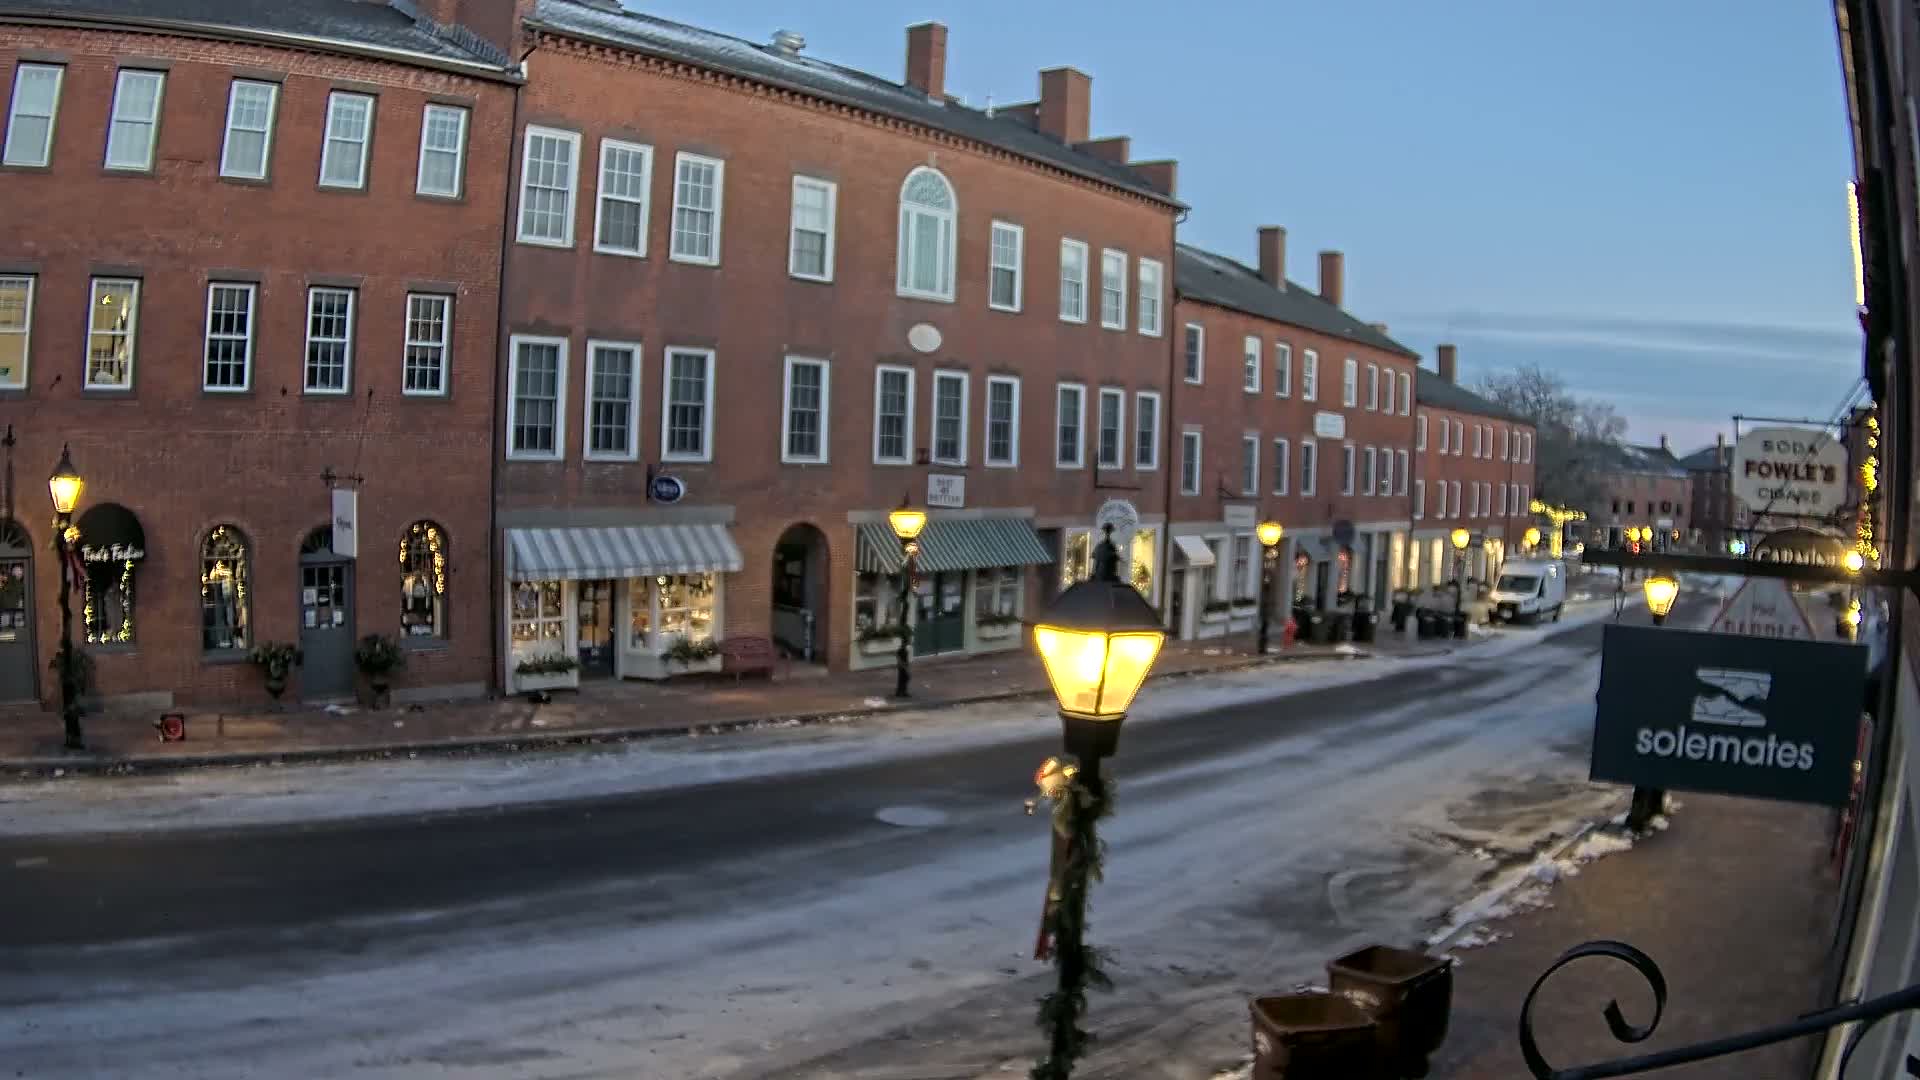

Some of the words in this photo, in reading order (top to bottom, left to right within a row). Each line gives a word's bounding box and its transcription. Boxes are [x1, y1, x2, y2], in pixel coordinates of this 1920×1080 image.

[1762, 440, 1819, 456] SODA
[1744, 460, 1836, 484] FOWLE'S
[1635, 725, 1815, 770] solemates
